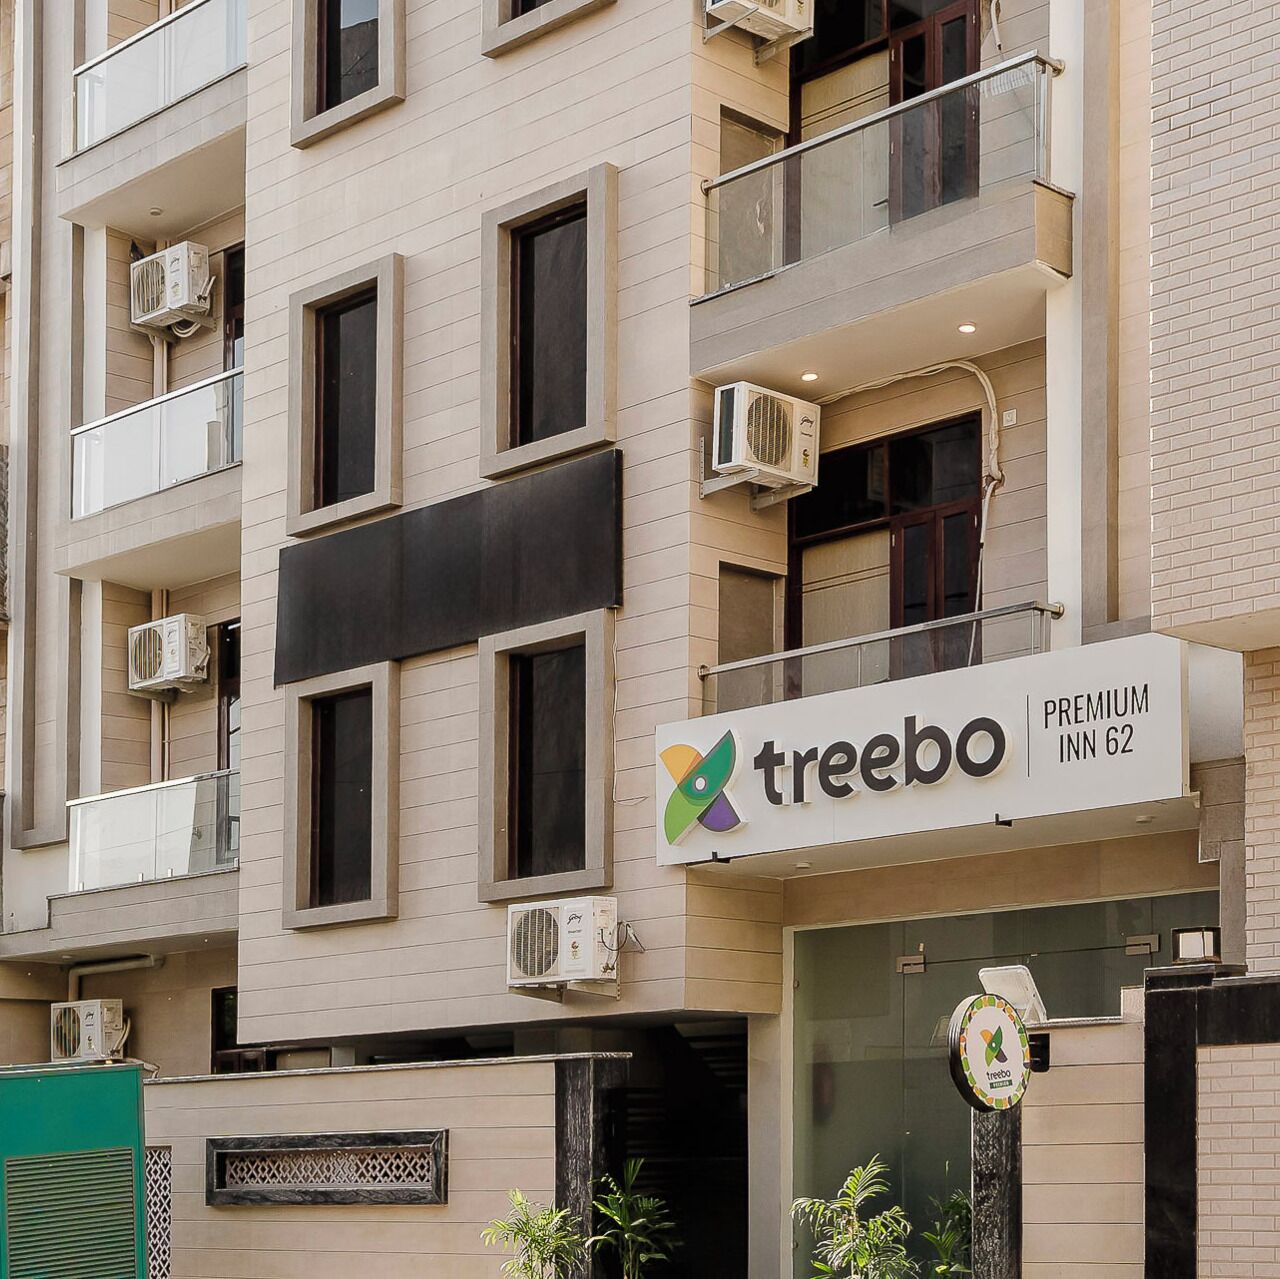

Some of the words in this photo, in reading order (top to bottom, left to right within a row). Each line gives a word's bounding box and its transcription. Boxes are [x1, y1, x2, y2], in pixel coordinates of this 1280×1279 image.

[1043, 683, 1149, 729] PREMIUM
[753, 714, 1007, 806] treebo
[1059, 728, 1096, 763] INN
[1105, 723, 1134, 756] 62
[986, 1069, 1011, 1080] treebo
